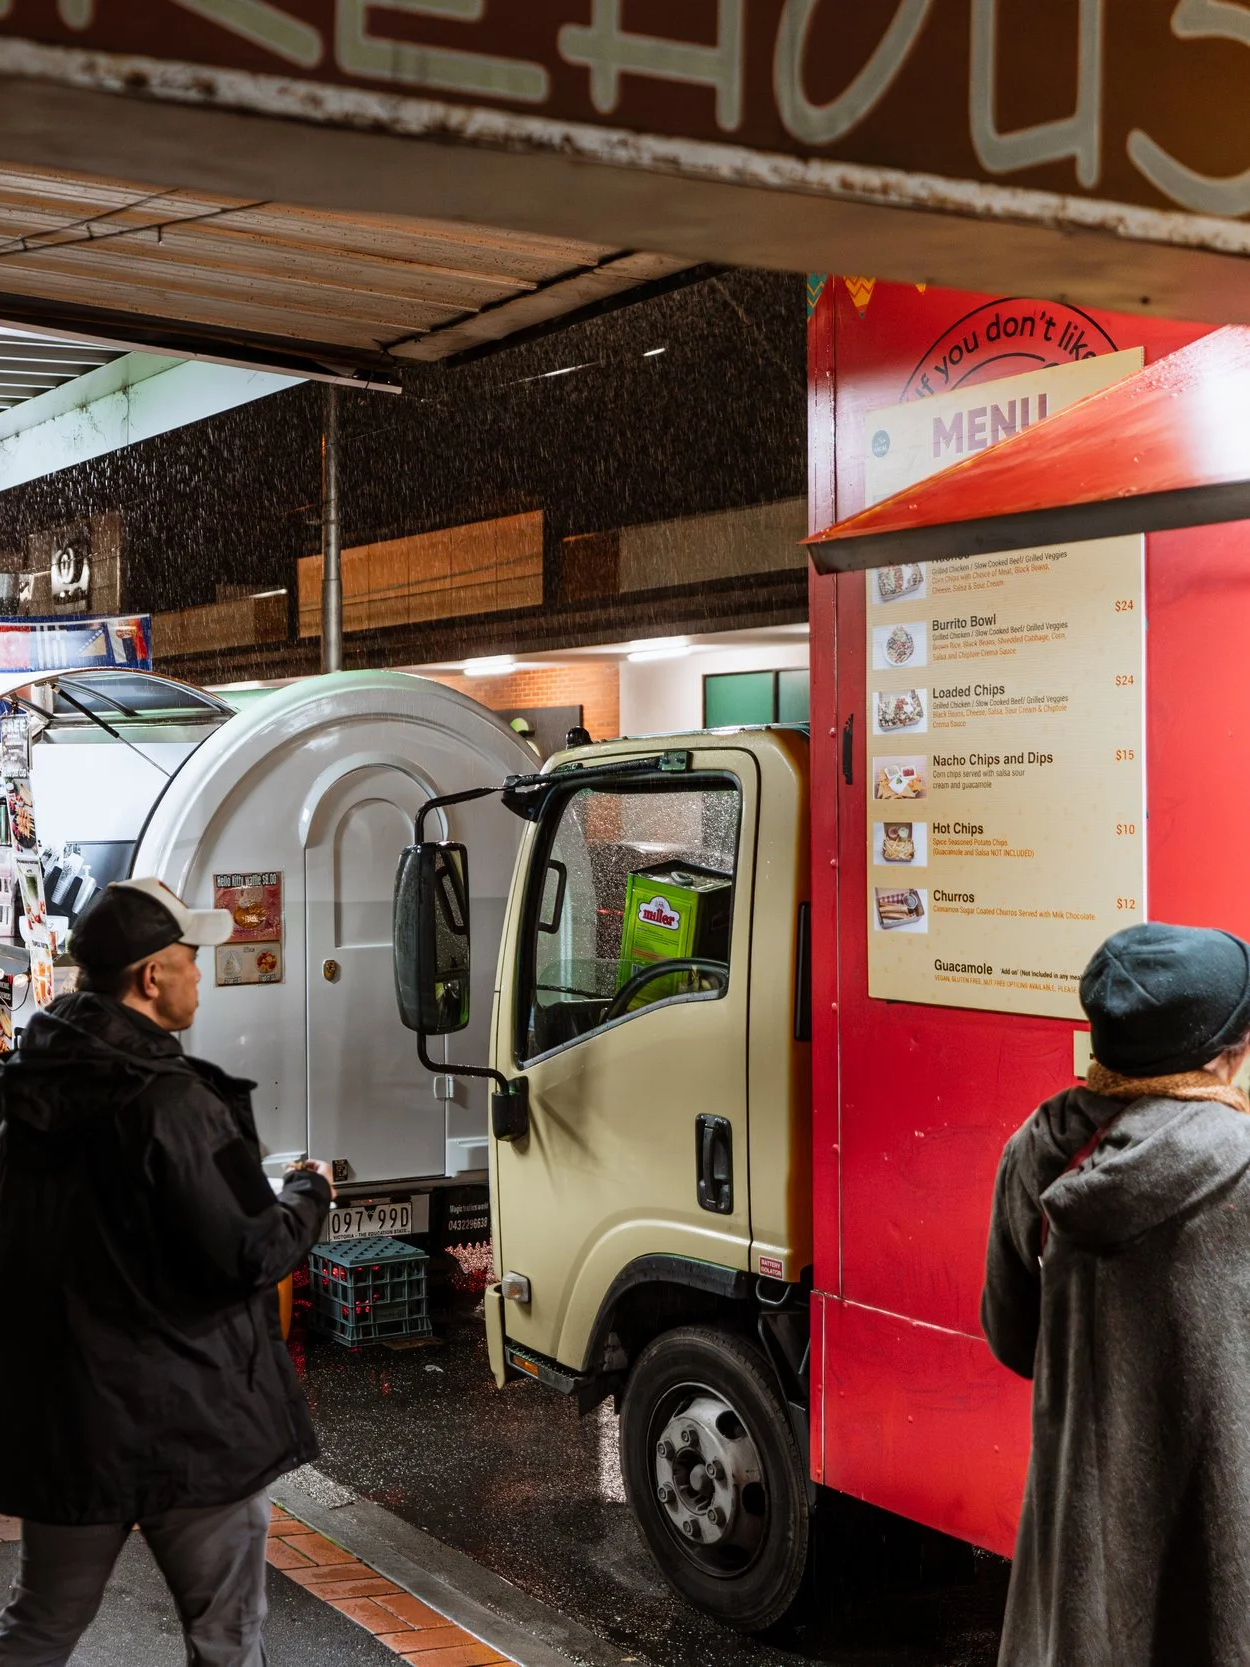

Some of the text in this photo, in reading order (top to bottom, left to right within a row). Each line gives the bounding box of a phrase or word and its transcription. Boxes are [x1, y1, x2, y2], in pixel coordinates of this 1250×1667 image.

[934, 331, 979, 384] you
[985, 310, 1056, 342] don't
[933, 393, 1047, 459] MENU
[932, 600, 1134, 631] Burrito Bowl $24
[932, 675, 1134, 699] Loaded Chips $24
[932, 750, 1134, 768] Nacho Chips and Dips $15
[932, 768, 1025, 779] Corn chips served with salsa sour
[932, 780, 992, 791] cream and guacamole
[932, 822, 1135, 836] Hot Chips $10
[990, 849, 1002, 857] NOT
[933, 889, 1135, 910] Churros $12
[960, 906, 975, 915] Sugar
[976, 907, 995, 915] Coated
[996, 908, 1018, 917] Churros
[1018, 909, 1038, 918] Served
[1052, 911, 1065, 919] Milk
[1065, 911, 1096, 921] Chocolate
[934, 959, 993, 975] Guacamole
[332, 1211, 363, 1234] 097
[761, 1259, 780, 1269] BATTERY
